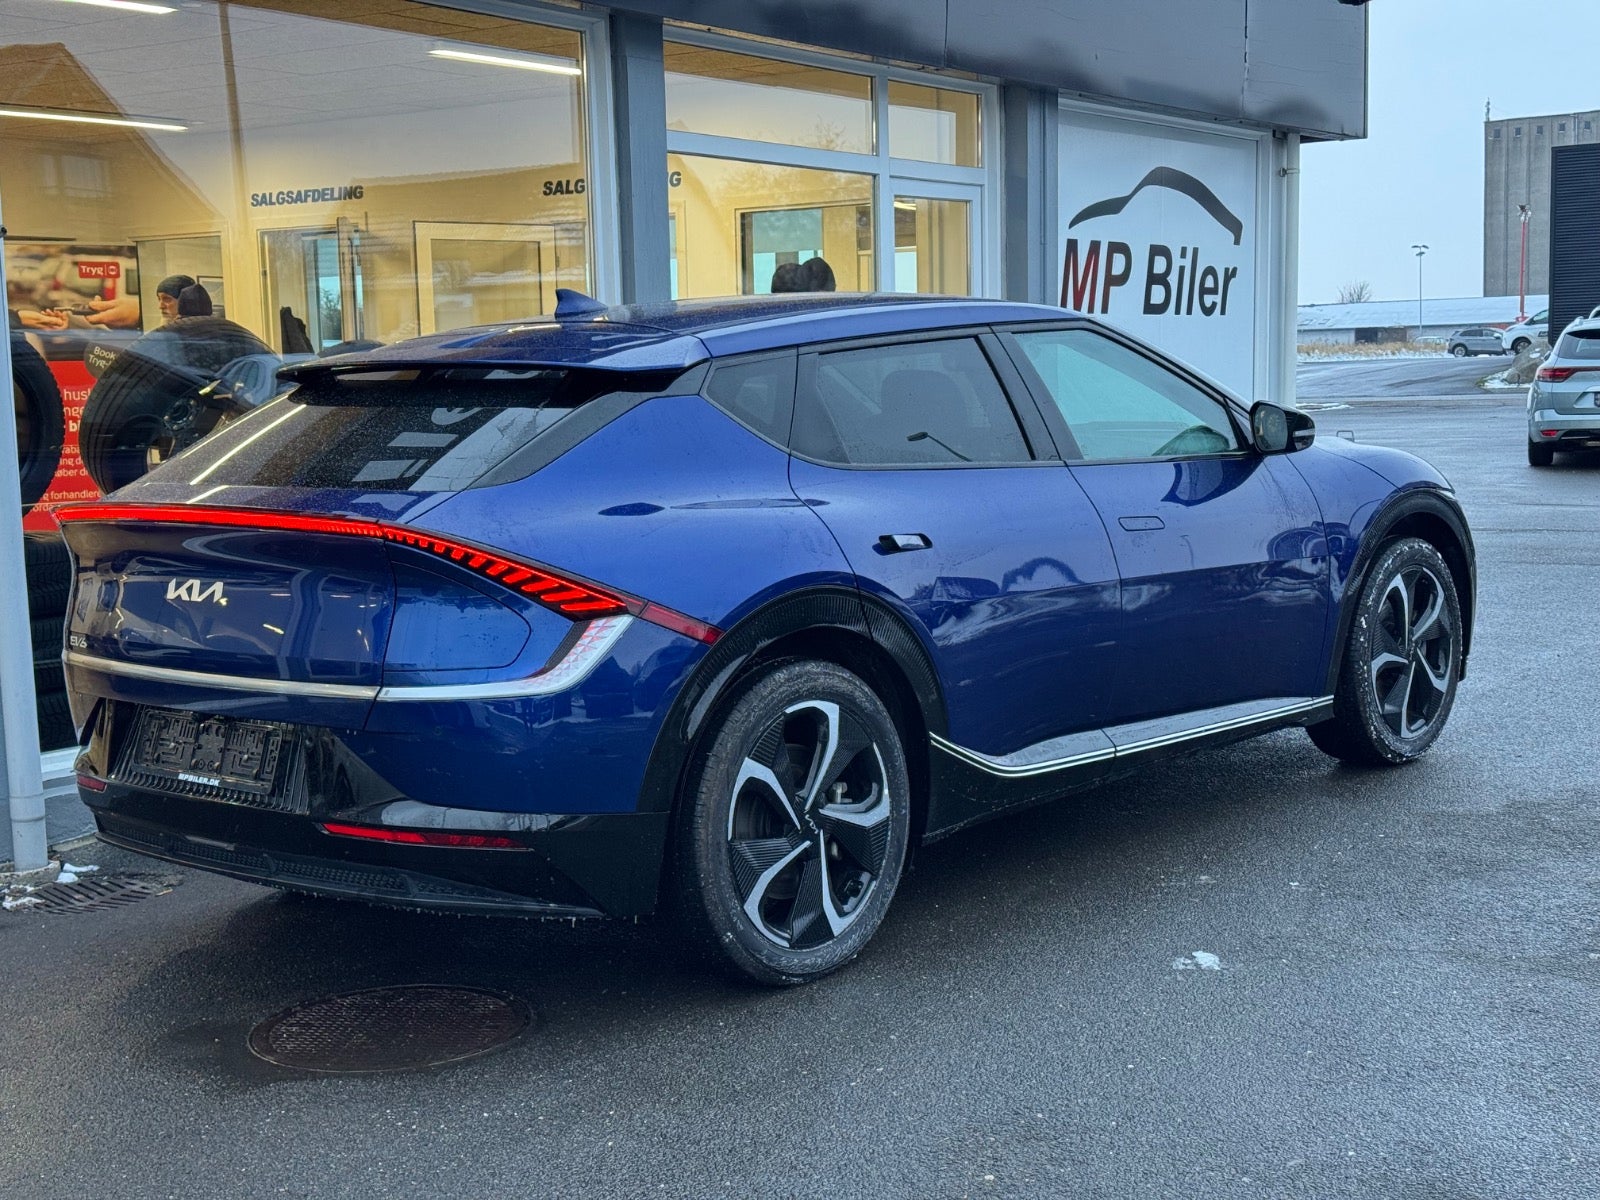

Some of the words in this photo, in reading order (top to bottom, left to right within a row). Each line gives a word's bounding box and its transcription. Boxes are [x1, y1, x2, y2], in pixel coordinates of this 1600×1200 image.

[251, 185, 364, 207] SALGSAFDELING
[80, 265, 104, 276] Tryg
[1060, 238, 1132, 314] MP
[1143, 243, 1238, 317] Biler
[94, 346, 116, 360] Book
[166, 577, 224, 603] KIA
[70, 635, 88, 649] EV6
